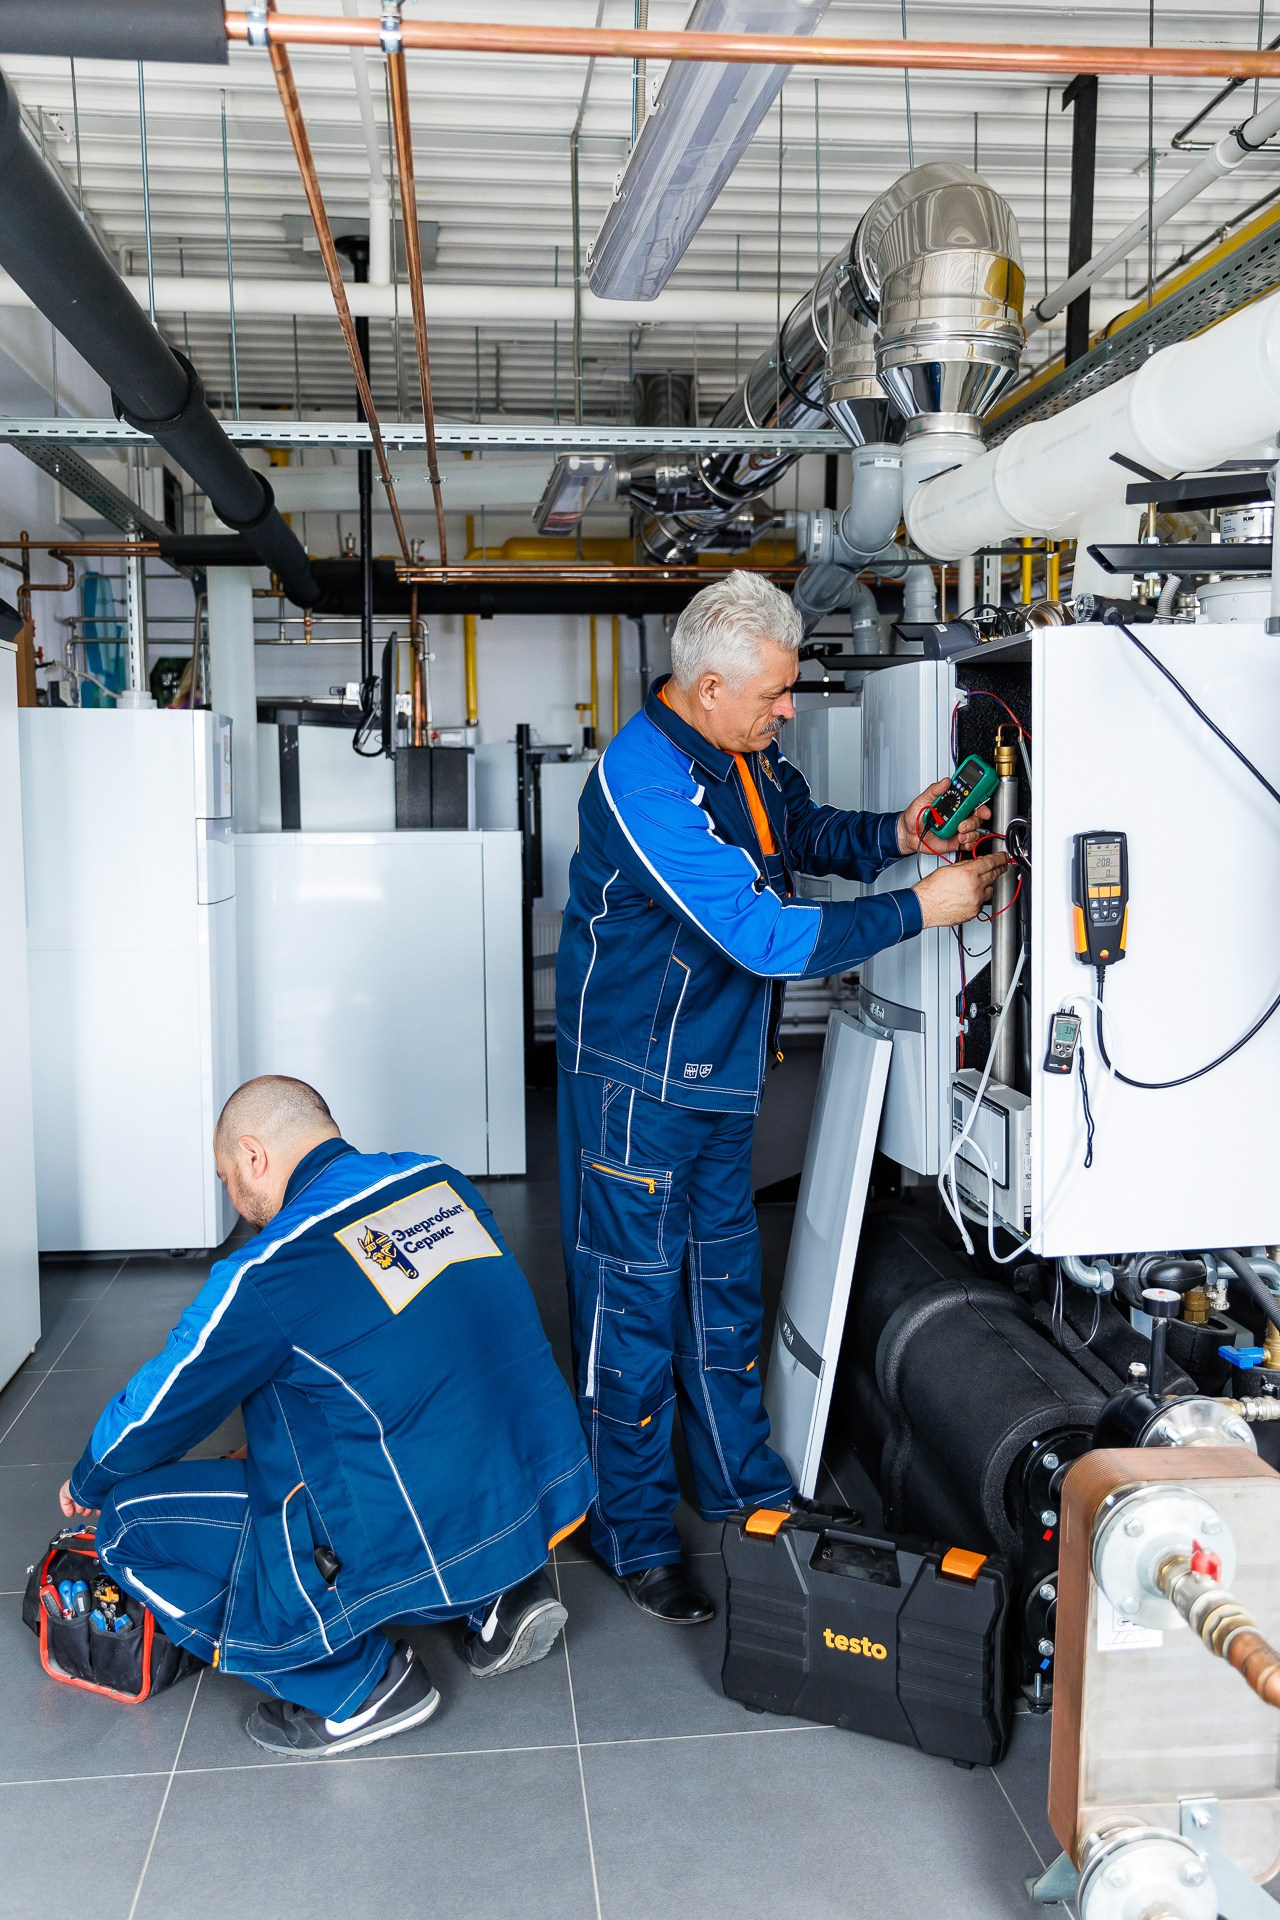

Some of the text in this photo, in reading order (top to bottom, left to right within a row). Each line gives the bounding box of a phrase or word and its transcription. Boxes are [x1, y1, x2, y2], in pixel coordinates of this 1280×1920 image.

[391, 1204, 465, 1242] Энергобыт
[403, 1226, 454, 1253] Сервис
[823, 1628, 887, 1660] testo
